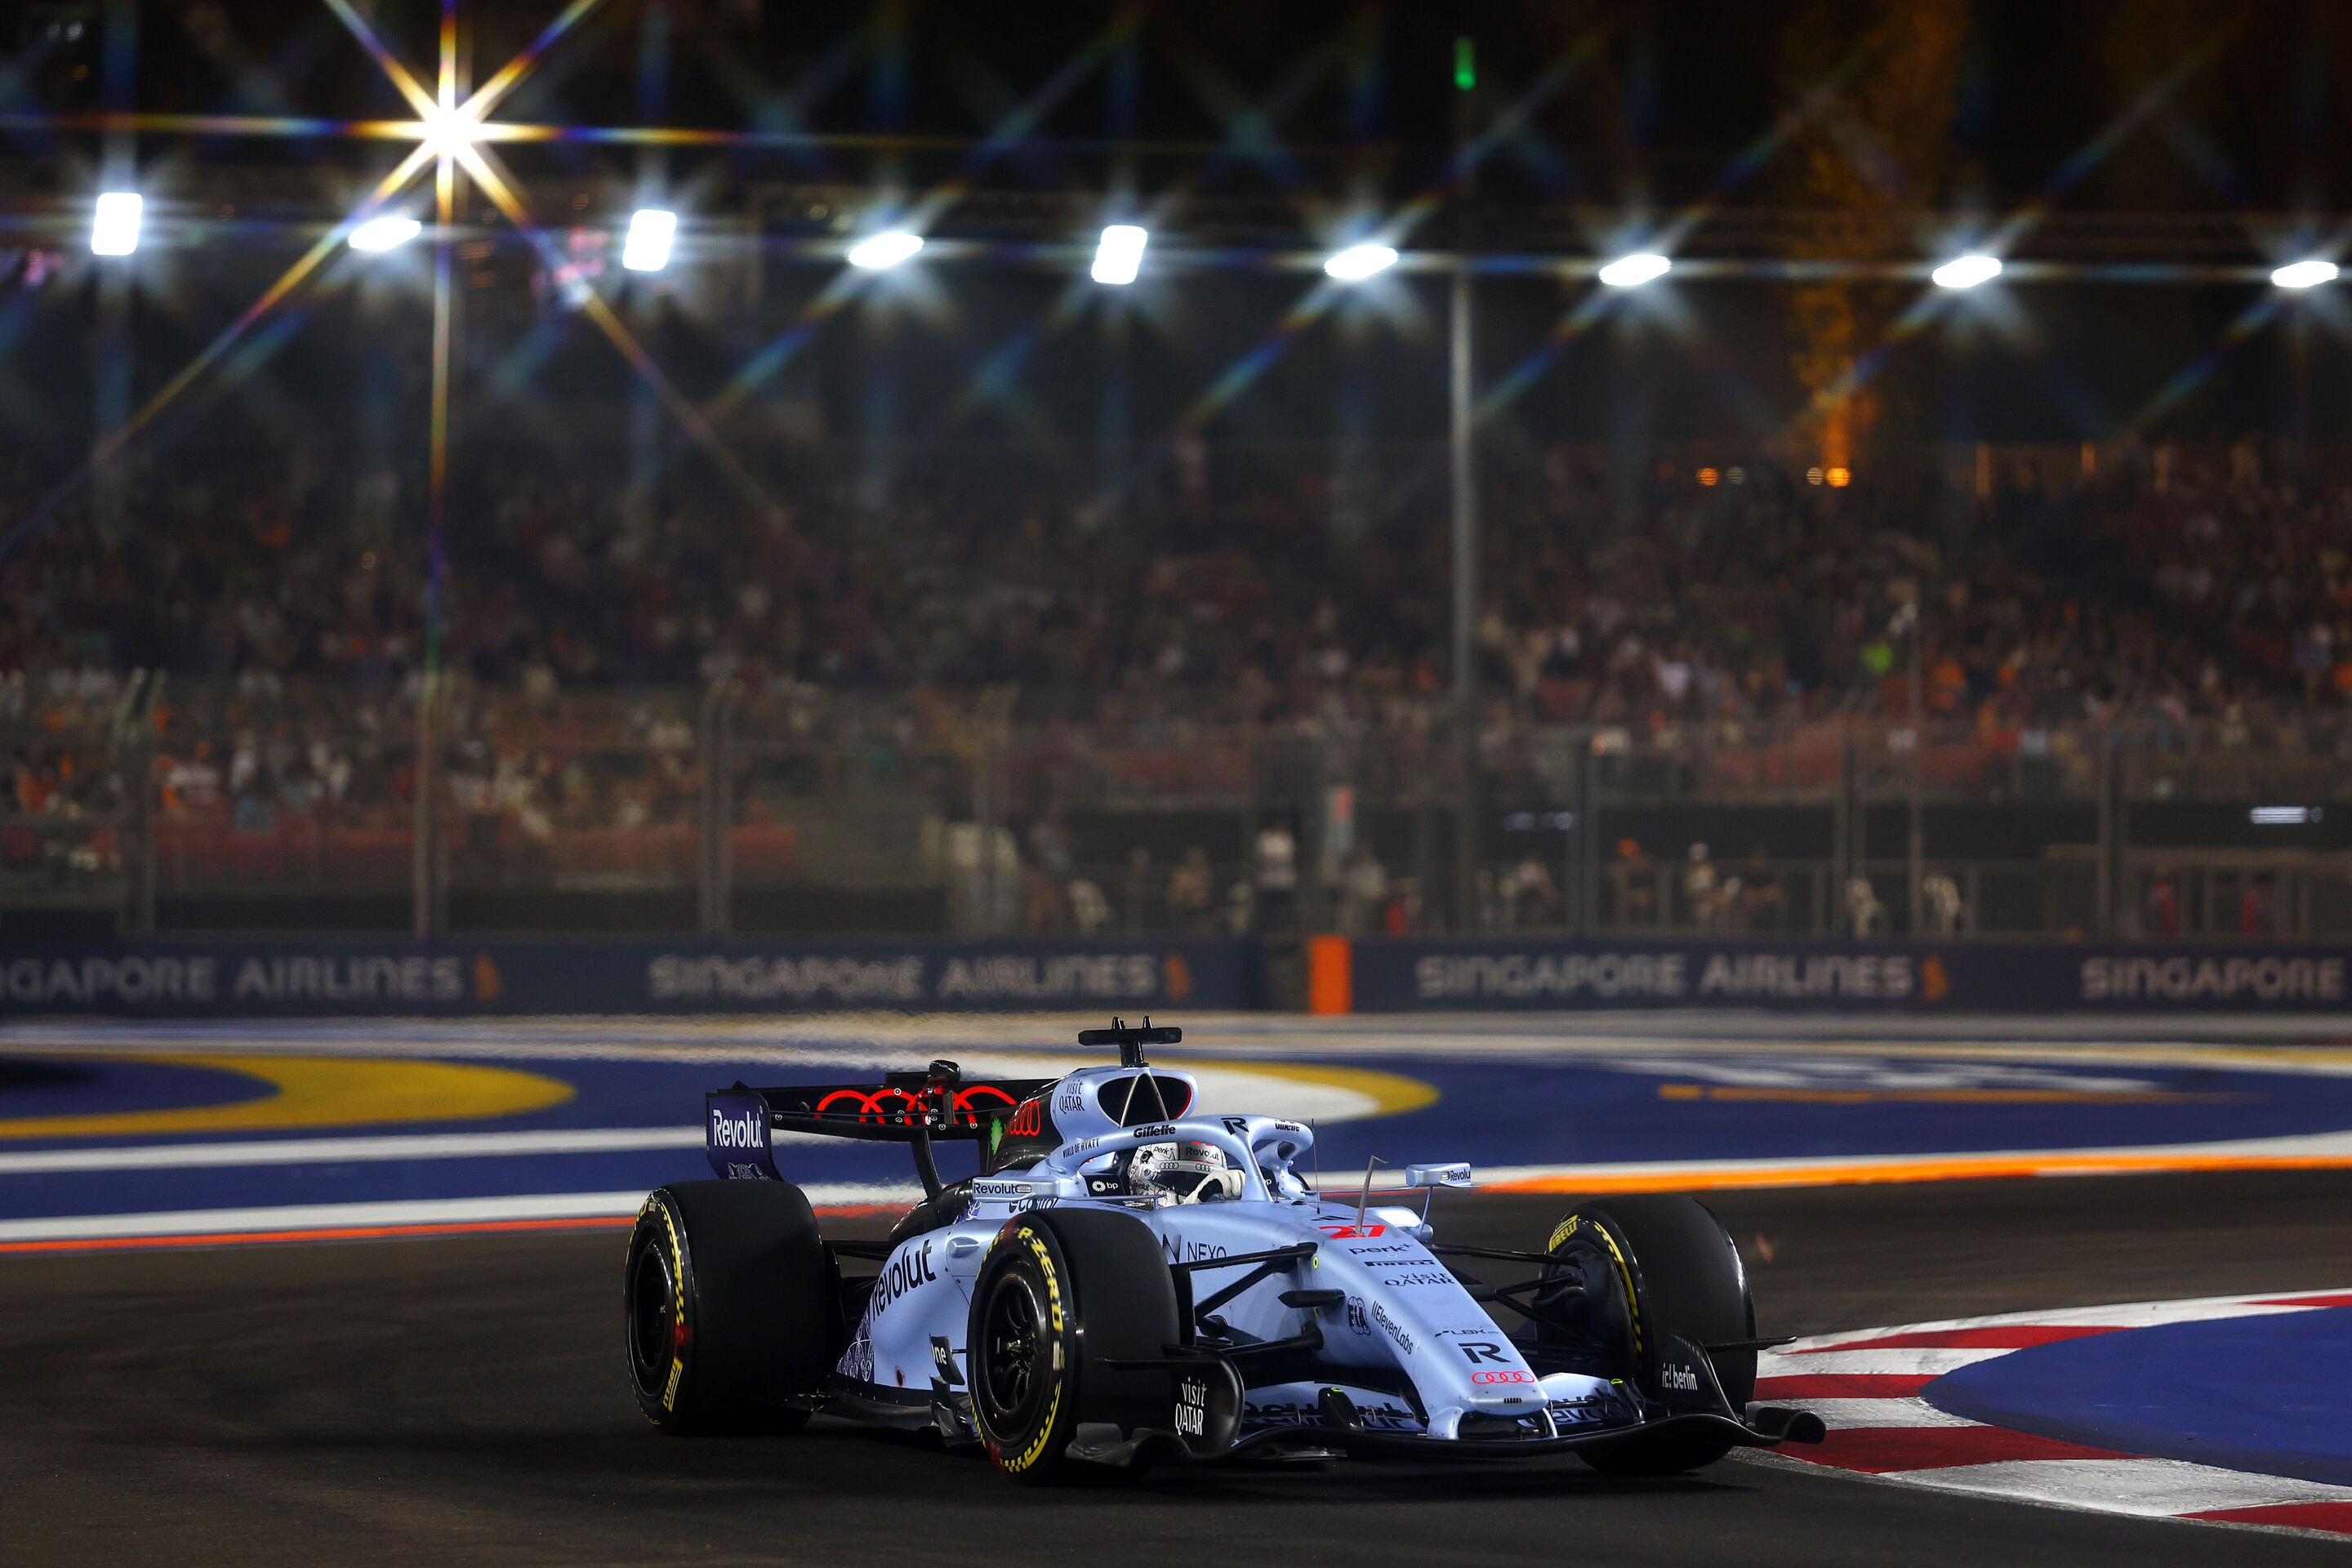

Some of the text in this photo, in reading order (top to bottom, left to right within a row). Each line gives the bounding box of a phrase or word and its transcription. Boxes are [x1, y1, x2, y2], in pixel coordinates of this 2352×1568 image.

[0, 956, 463, 1002] GAPORE AIRLINES
[647, 955, 1157, 1000] SINGAPORE AIRLINES
[1416, 954, 1913, 999] SINGAPORE AIRLINES
[2080, 956, 2345, 1000] SINGAPORE
[1058, 1095, 1085, 1114] QATAR
[713, 1109, 764, 1148] Revolut
[1134, 1125, 1176, 1138] Gillette
[1186, 1147, 1219, 1161] Revout
[1107, 1182, 1119, 1191] bp
[1450, 1169, 1471, 1182] Revolu
[973, 1183, 1016, 1195] Revolut
[1318, 1225, 1387, 1239] 27
[1458, 1342, 1512, 1364] R
[1673, 1363, 1698, 1391] berlin
[1182, 1376, 1207, 1406] visit
[1175, 1403, 1204, 1436] QATAR
